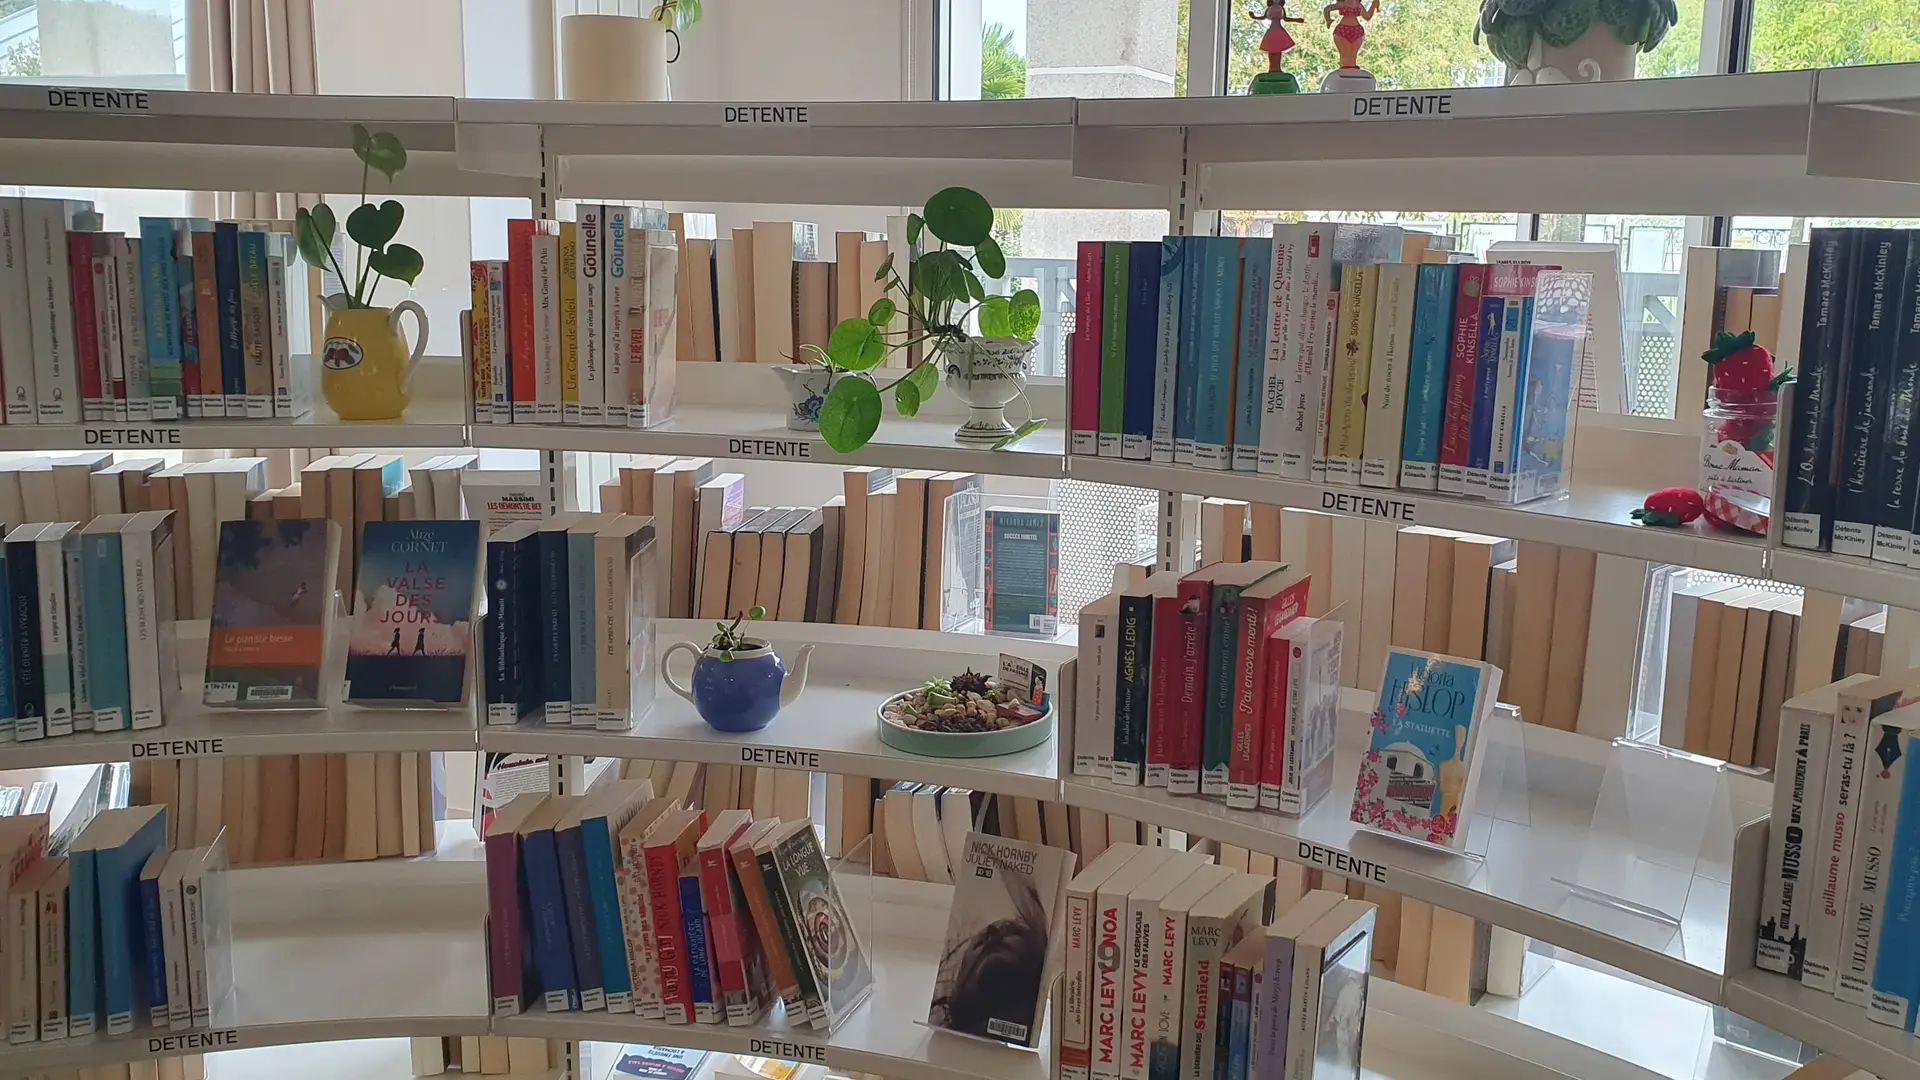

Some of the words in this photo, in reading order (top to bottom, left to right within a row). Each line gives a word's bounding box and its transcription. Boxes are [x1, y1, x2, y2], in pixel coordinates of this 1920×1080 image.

[48, 90, 149, 109] DETENTE
[1354, 95, 1452, 117] DETENTE
[724, 106, 808, 123] DETENTE
[583, 214, 596, 278] Gounelle
[610, 214, 624, 278] Gounelle
[1274, 244, 1285, 290] Queenie
[1875, 242, 1891, 290] McKinley
[1273, 295, 1282, 307] de
[1817, 291, 1829, 327] Tamara
[1869, 293, 1882, 330] Tamara
[1271, 313, 1281, 343] Lettre
[1456, 318, 1467, 357] SOPHIE
[1465, 313, 1478, 364] KINSELLA
[1269, 348, 1279, 360] La
[1267, 374, 1276, 413] RACHEL
[1275, 380, 1284, 410] JOYCE
[84, 429, 181, 445] DETENTE
[729, 439, 810, 458] DETENTE
[1322, 492, 1416, 521] DETENTE
[405, 561, 428, 573] LA
[387, 577, 446, 590] VALSE
[396, 594, 432, 607] DES
[1125, 618, 1136, 647] LEDIG
[1124, 650, 1134, 682] AGNÈS
[1411, 661, 1454, 687] Vtoria
[132, 738, 224, 758] DETENTE
[1799, 724, 1810, 746] PARIS
[1842, 743, 1855, 753] là
[741, 748, 819, 768] DETENTE
[1840, 757, 1852, 805] seras-tu
[1791, 805, 1802, 823] UN
[971, 841, 994, 856] NICK
[997, 845, 1038, 864] HORNBY
[1298, 843, 1387, 883] DETENTE
[1782, 827, 1803, 881] MUSSO
[1824, 856, 1839, 916] guillaume
[1833, 813, 1844, 852] musso
[1072, 906, 1081, 925] LEVY
[1853, 903, 1873, 971] UILLAUME
[1864, 847, 1879, 893] MUSSO
[1072, 927, 1080, 948] MARC
[1165, 917, 1175, 947] LEVY
[1191, 927, 1220, 937] MARC
[1192, 938, 1219, 946] LEVY
[1163, 951, 1173, 985] MARC
[1101, 965, 1115, 1008] LEVY
[1132, 969, 1147, 1013] LEVY
[1195, 960, 1209, 1030] Stanfield
[149, 1030, 238, 1053] DETENTE
[750, 1040, 825, 1061] DETENTE
[1100, 1012, 1113, 1063] MARC
[1130, 1017, 1145, 1068] MARC
